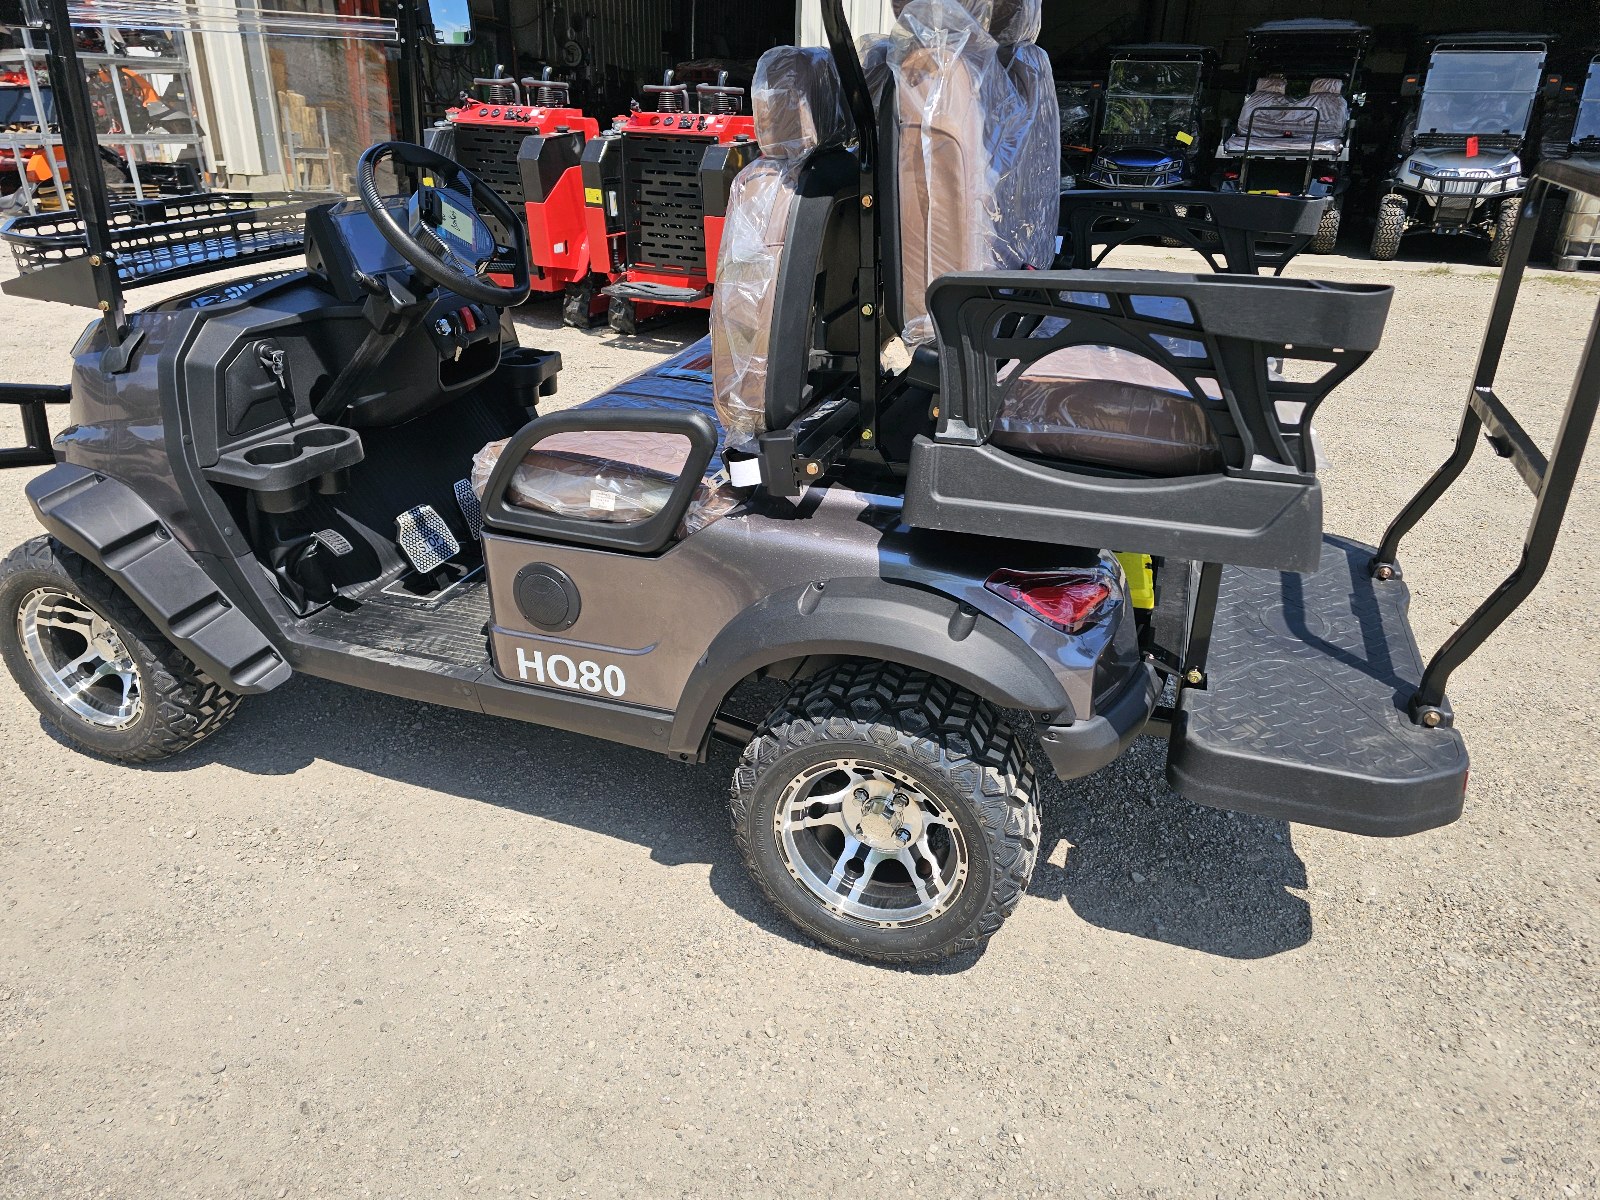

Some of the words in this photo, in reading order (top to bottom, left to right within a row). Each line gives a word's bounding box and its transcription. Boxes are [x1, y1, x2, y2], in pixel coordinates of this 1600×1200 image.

[463, 491, 474, 503] GO
[418, 533, 440, 553] STOP
[516, 647, 626, 697] HQ80
